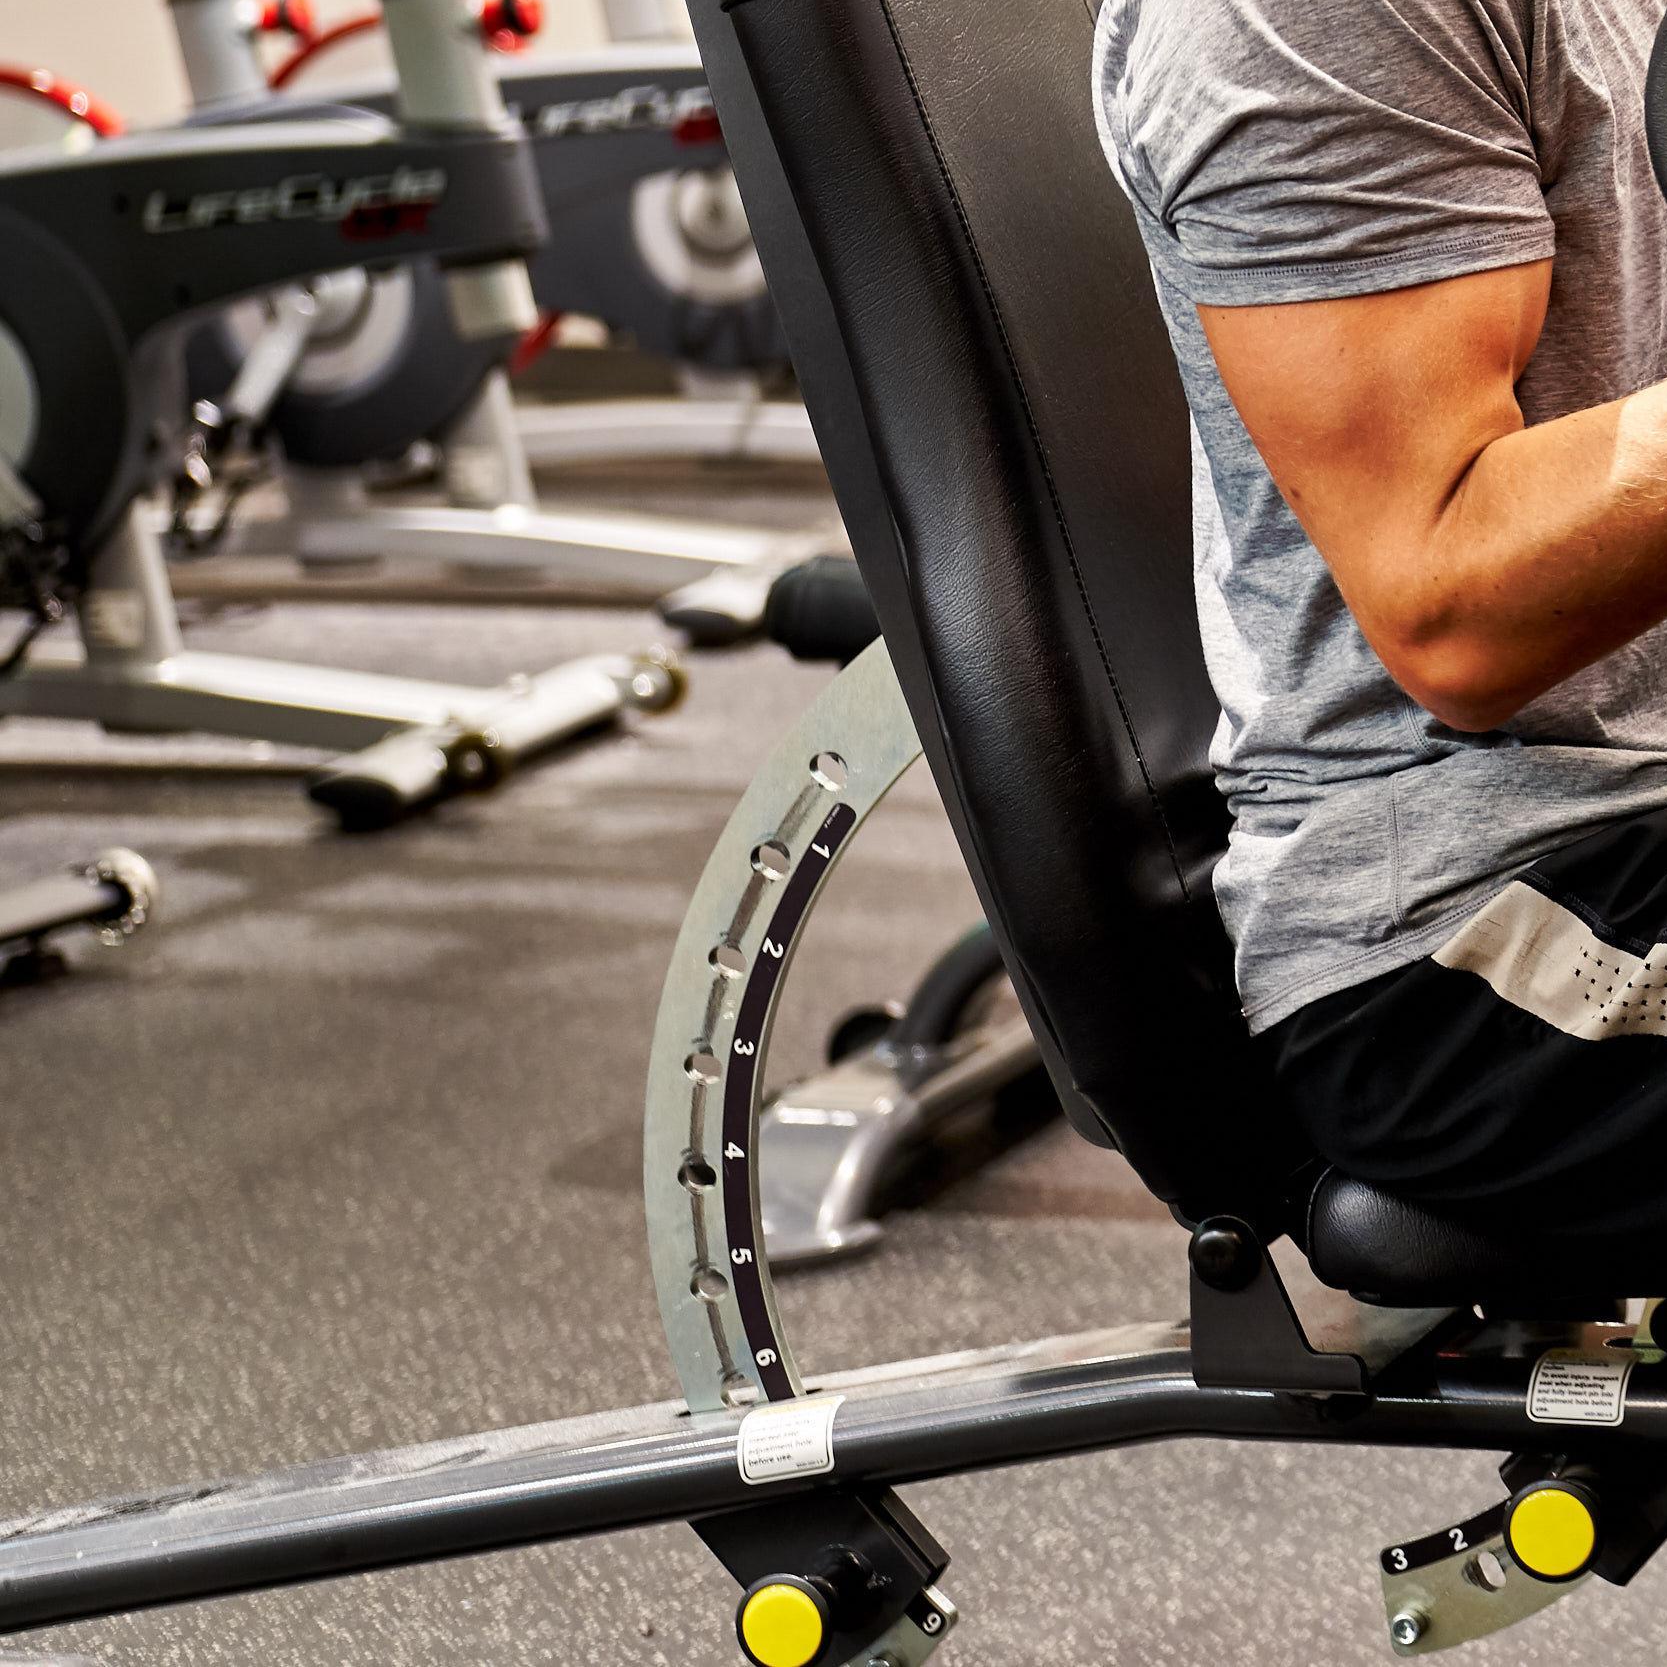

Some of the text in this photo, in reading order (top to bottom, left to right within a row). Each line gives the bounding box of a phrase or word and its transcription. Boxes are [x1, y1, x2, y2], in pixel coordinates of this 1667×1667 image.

[811, 842, 830, 859] 1
[762, 937, 784, 959] 2
[734, 1038, 755, 1056] 3
[724, 1141, 745, 1160] 4
[731, 1248, 753, 1265] 5
[756, 1348, 777, 1367] 6
[1391, 1528, 1469, 1570] 3 2
